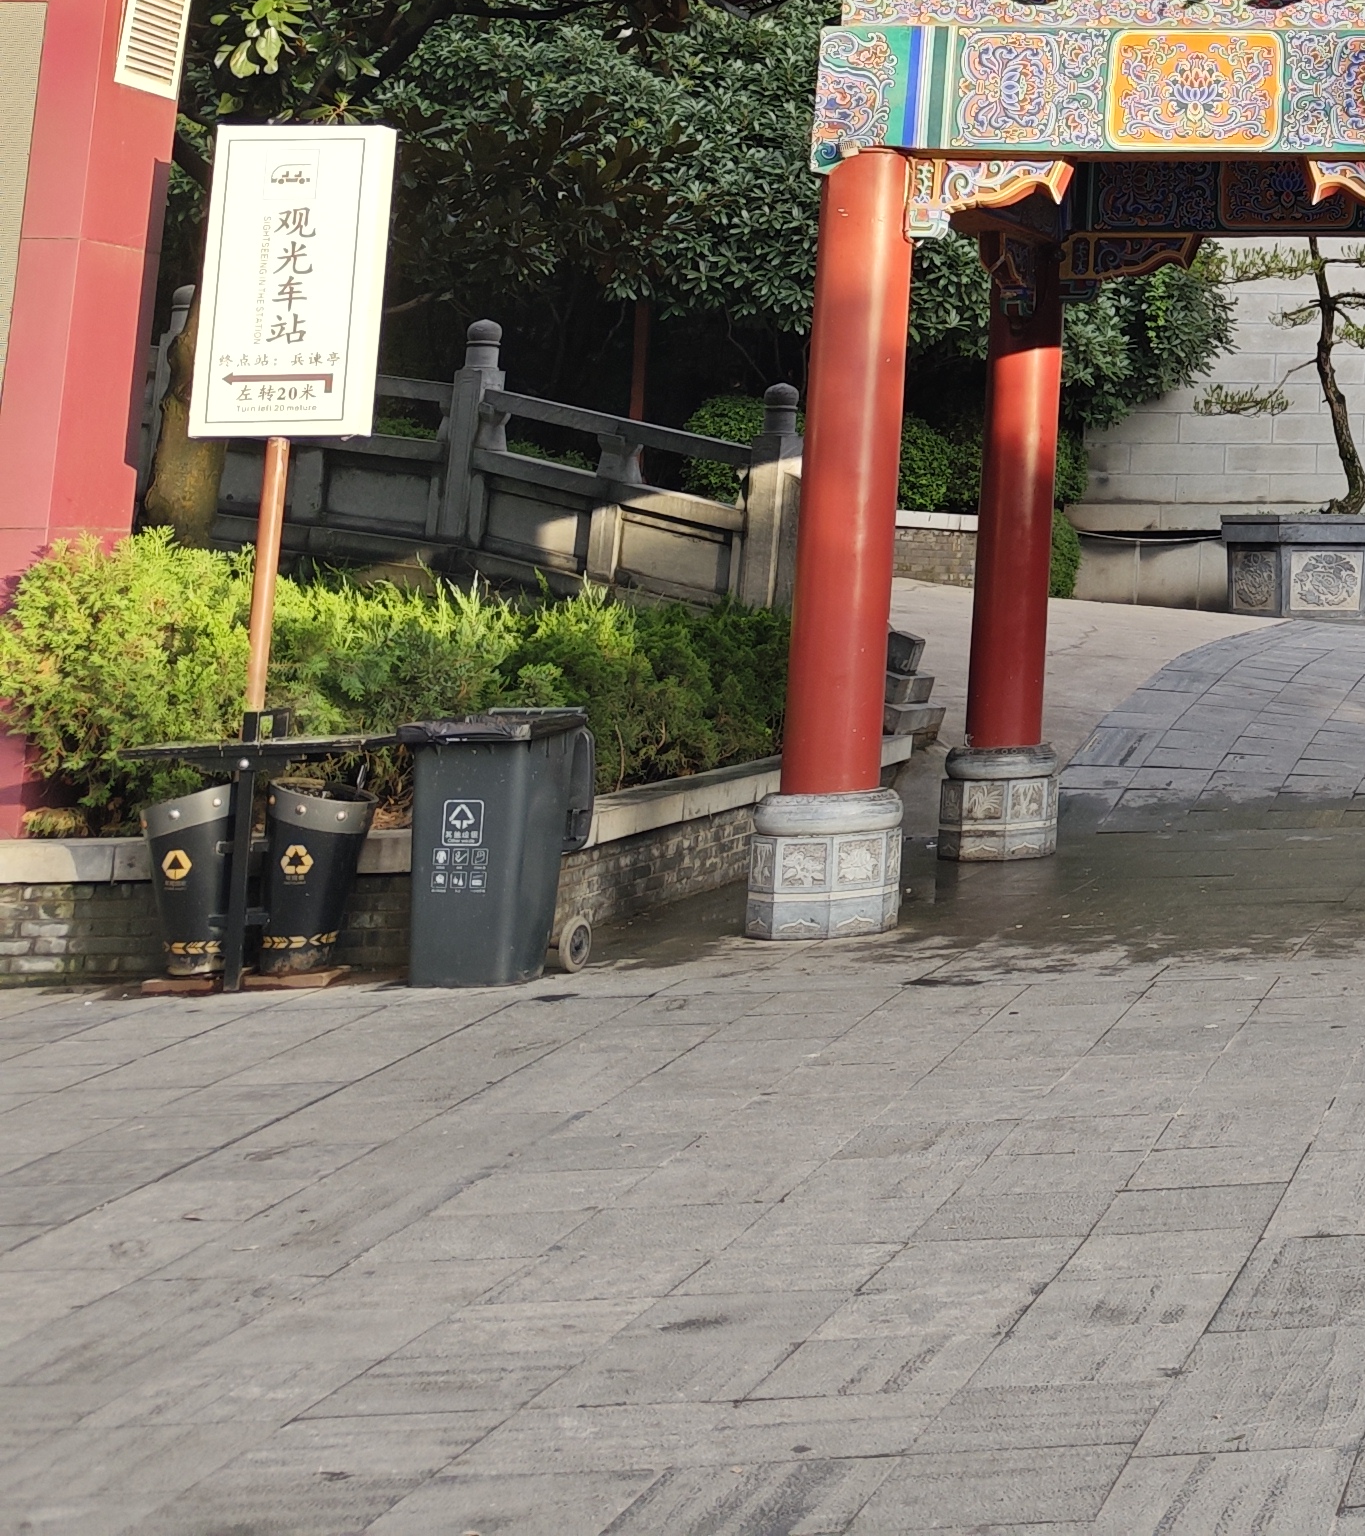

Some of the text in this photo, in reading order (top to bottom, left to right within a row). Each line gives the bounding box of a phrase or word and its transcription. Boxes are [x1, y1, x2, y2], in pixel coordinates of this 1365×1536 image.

[258, 216, 271, 275] SIGHTSEEING
[266, 207, 316, 344] 观光车站
[253, 307, 265, 345] STATION
[236, 384, 316, 401] 左转20米
